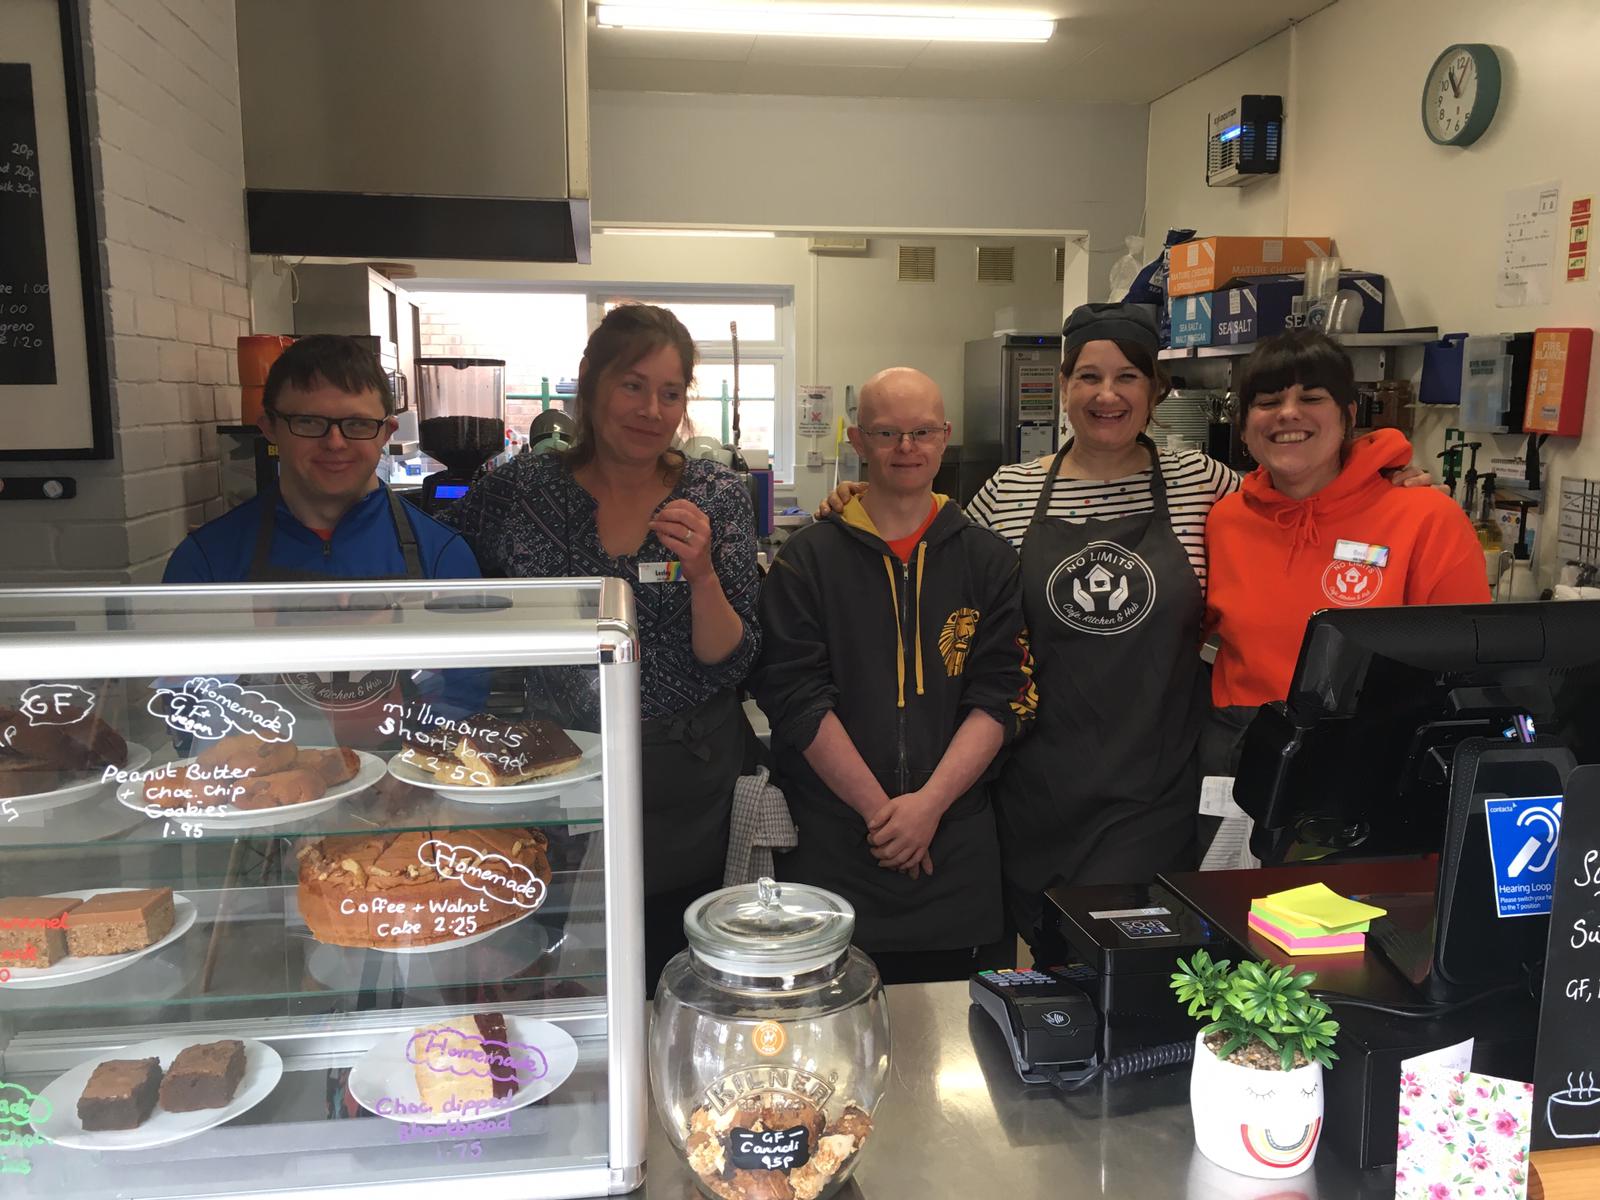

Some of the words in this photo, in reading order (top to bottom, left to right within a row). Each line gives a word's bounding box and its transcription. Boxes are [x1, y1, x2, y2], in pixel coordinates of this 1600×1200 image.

[1457, 57, 1466, 70] 12
[1441, 80, 1450, 92] 10
[1438, 95, 1443, 107] 9
[1439, 108, 1445, 120] 8
[1446, 118, 1452, 131] 7
[1454, 119, 1460, 132] 6
[11, 143, 34, 160] 20p
[14, 165, 34, 181] 20p
[1218, 322, 1232, 335] SEA
[1234, 319, 1252, 333] SALT
[1066, 557, 1086, 573] NO
[1090, 551, 1135, 570] LIMITS
[1081, 614, 1117, 626] Kitchen
[1116, 612, 1125, 622] &
[1124, 602, 1140, 619] Hub
[27, 692, 73, 715] GF
[192, 680, 283, 733] Homemade
[170, 714, 214, 737] vegan
[101, 761, 177, 784] Peanut
[184, 763, 257, 781] Butter
[1490, 805, 1513, 813] contacta
[162, 822, 203, 839] 1.95
[435, 849, 537, 899] Homemade
[1499, 884, 1530, 895] Hearing
[1531, 883, 1552, 892] Loop
[340, 897, 406, 915] Coffee
[428, 898, 490, 914] Walnut
[377, 919, 421, 937] Cake
[1566, 978, 1592, 1003] GF,
[424, 1036, 538, 1073] Homemade
[712, 1068, 829, 1108] KILNER
[442, 1089, 513, 1116] dipped
[762, 1132, 785, 1144] GF
